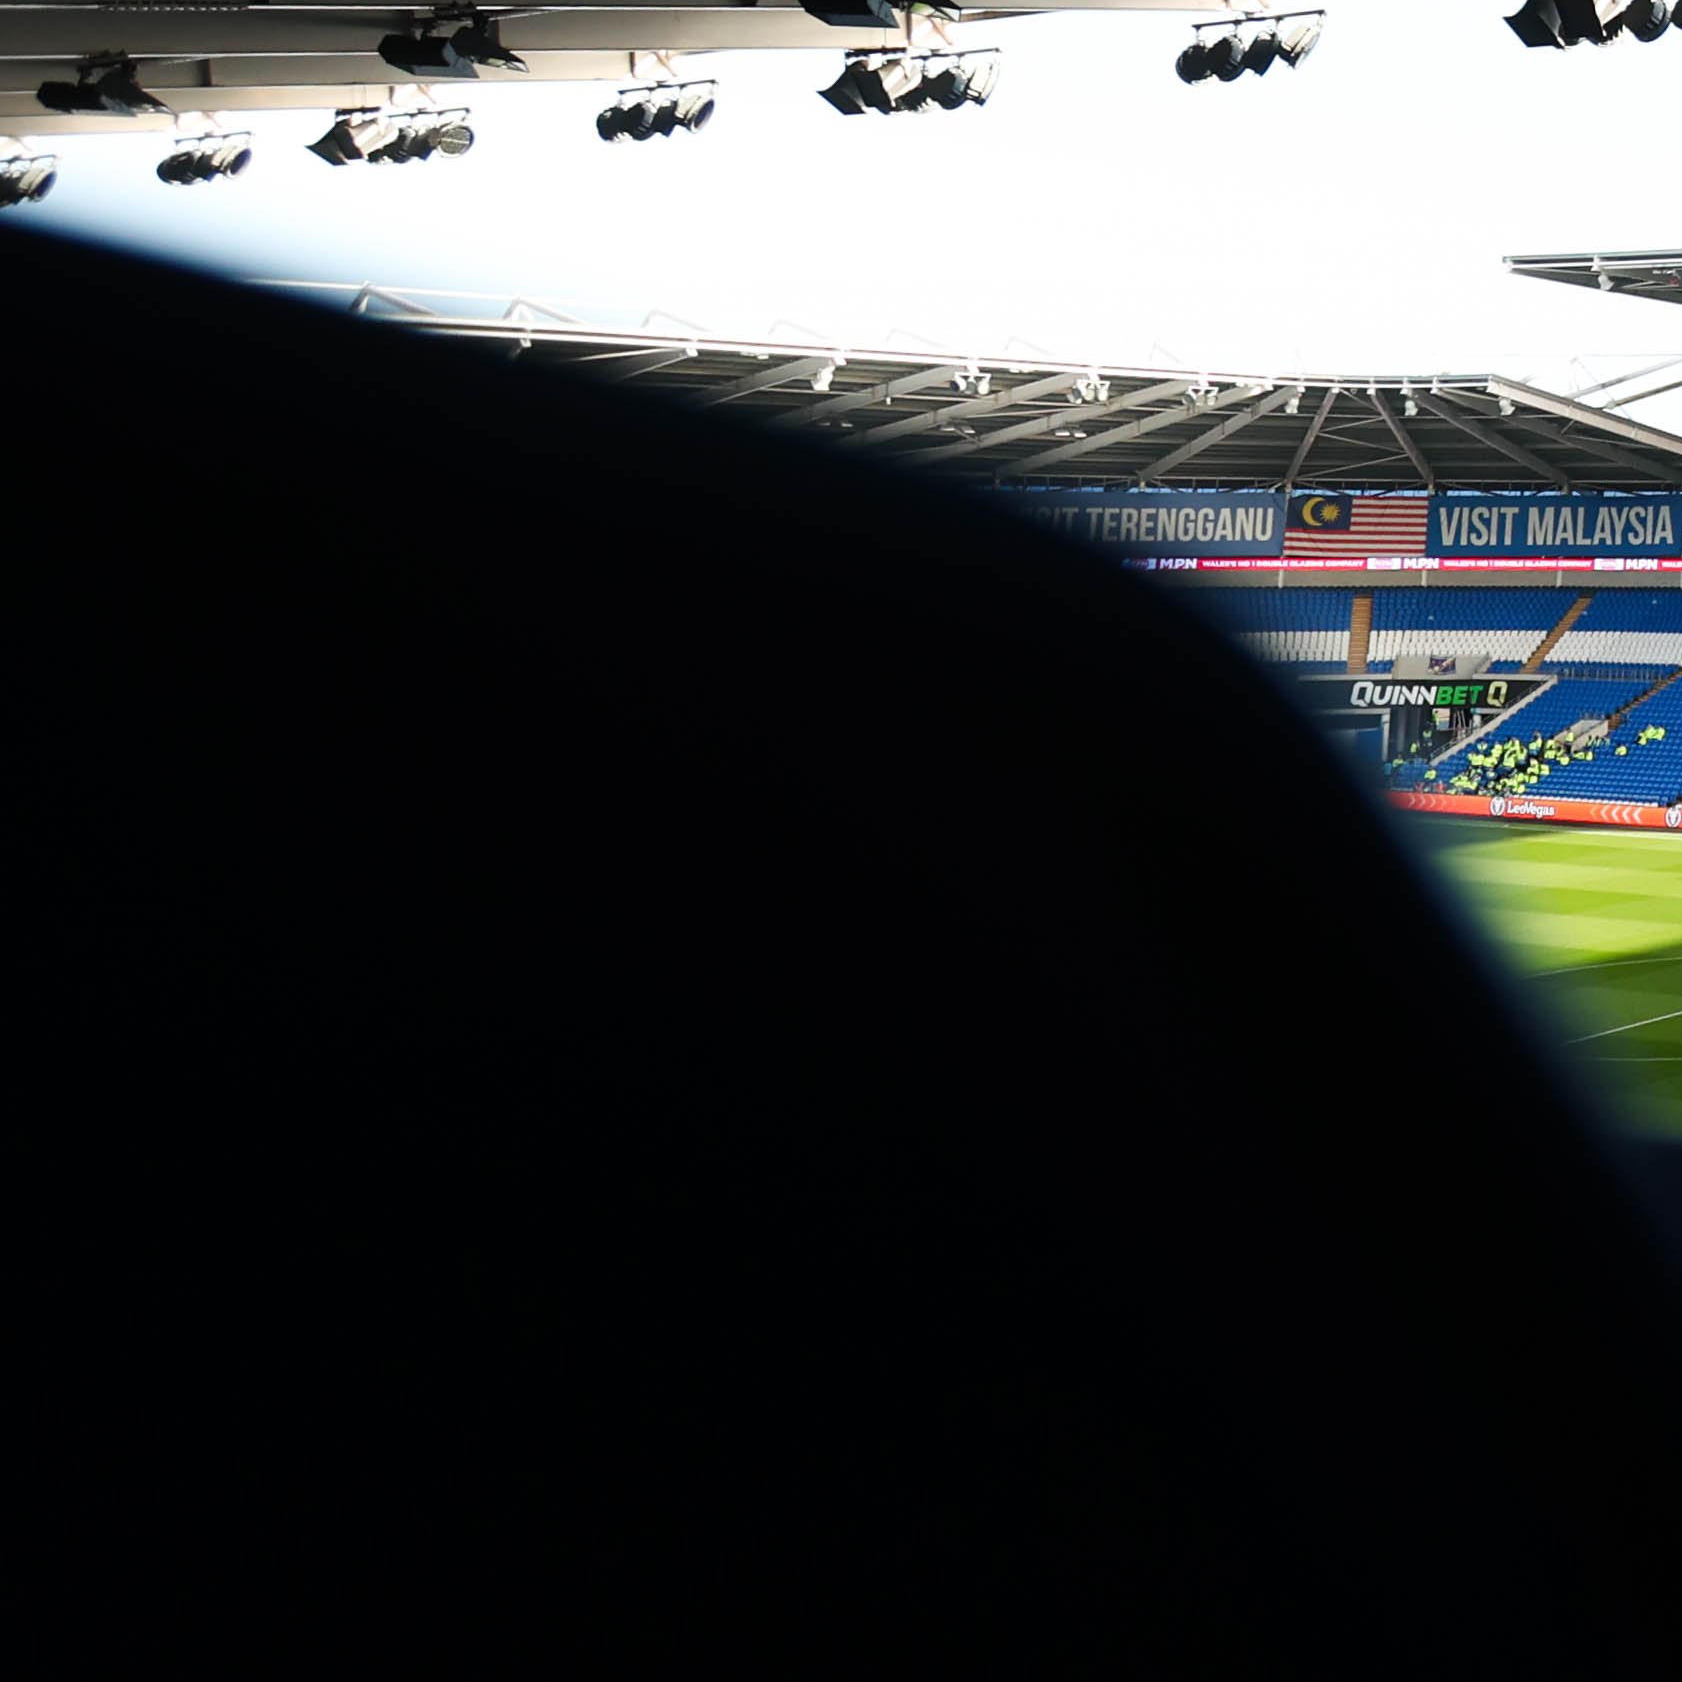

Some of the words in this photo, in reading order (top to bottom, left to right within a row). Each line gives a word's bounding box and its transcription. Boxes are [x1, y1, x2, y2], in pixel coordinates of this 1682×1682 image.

[1085, 507, 1274, 542] TERENGGANU
[1438, 506, 1520, 546] VISIT
[1527, 505, 1675, 546] MALAYSIA
[1506, 800, 1556, 819] LeoVegas
